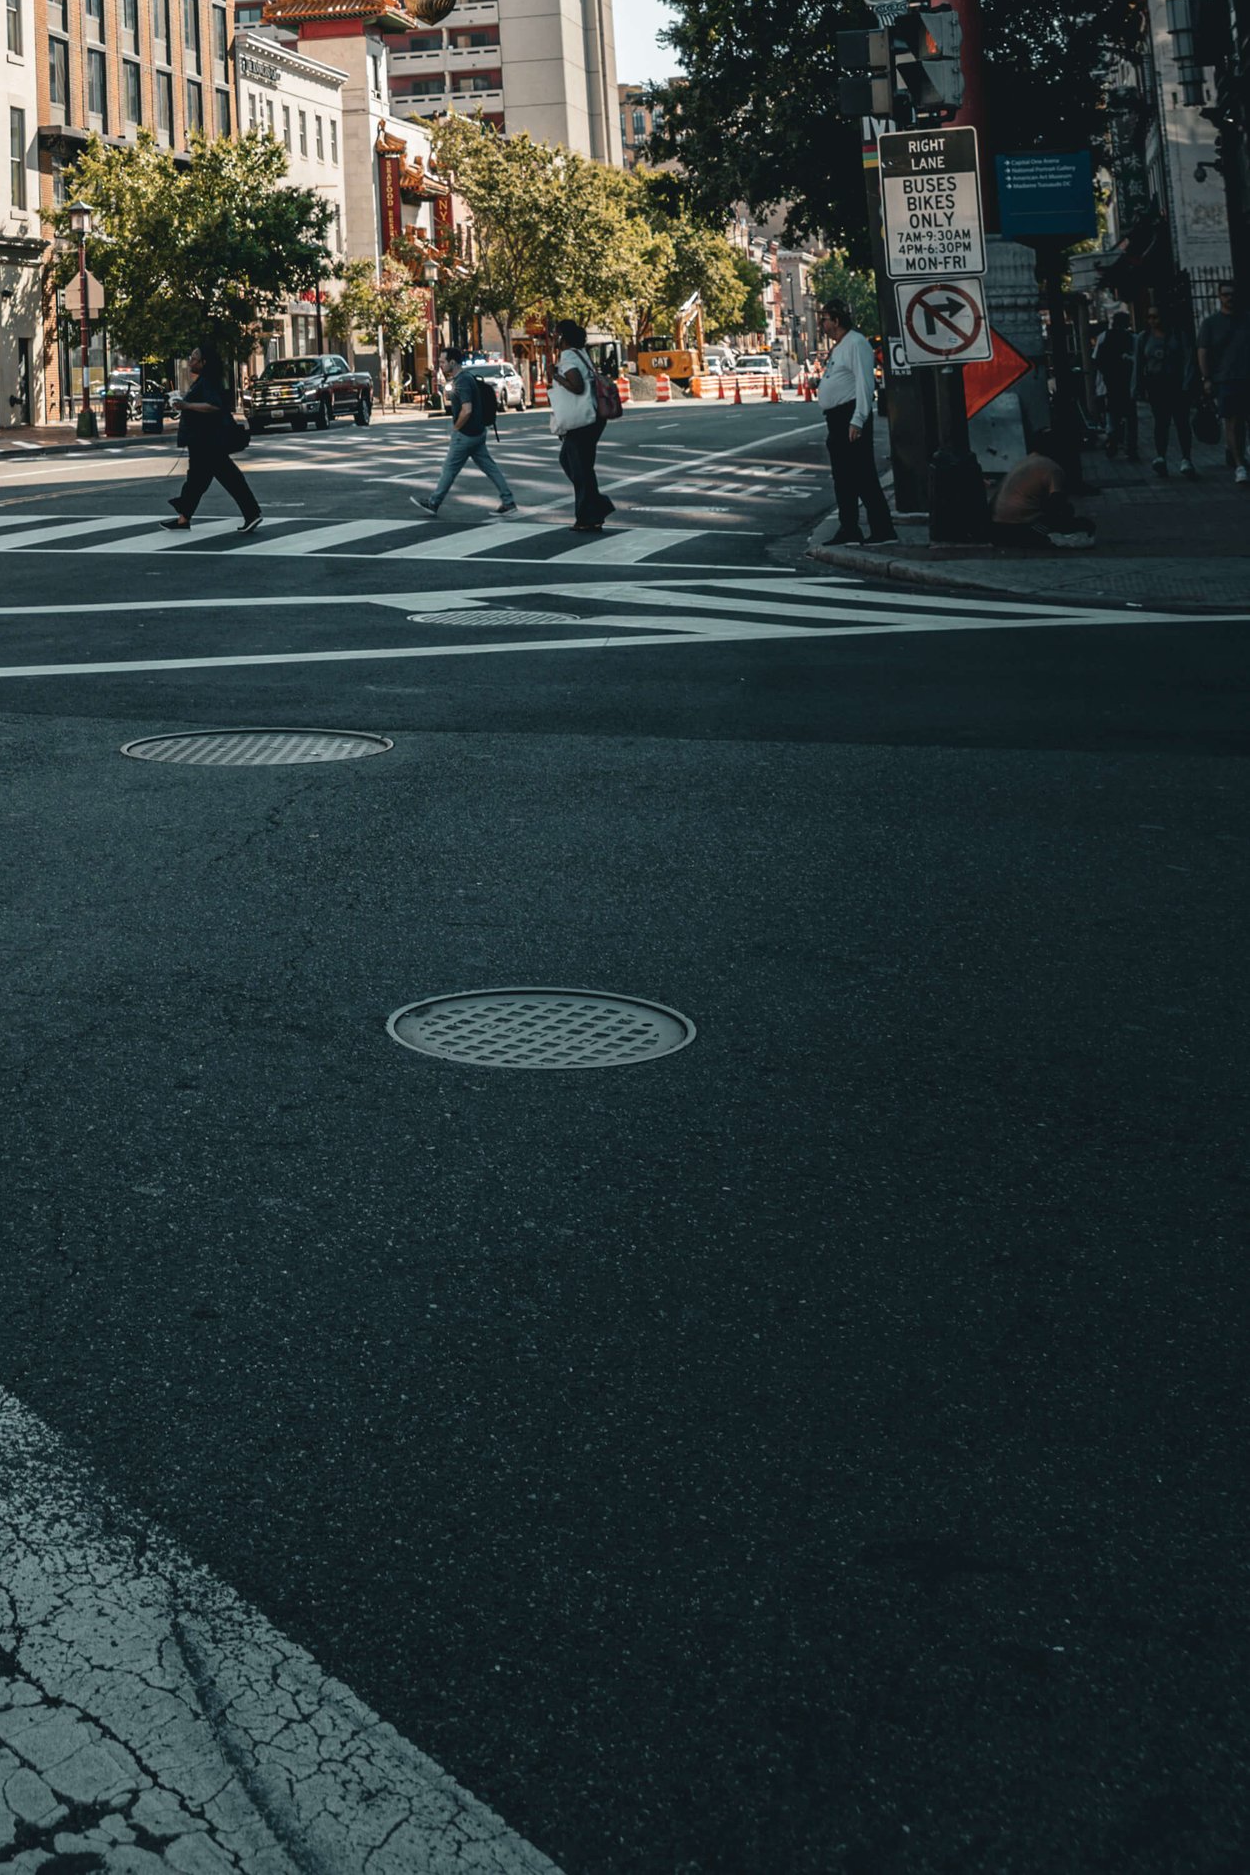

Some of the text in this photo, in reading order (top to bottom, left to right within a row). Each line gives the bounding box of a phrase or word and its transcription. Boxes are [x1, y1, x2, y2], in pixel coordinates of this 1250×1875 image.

[908, 138, 945, 153] RIGHT
[911, 156, 945, 170] LANE
[903, 176, 957, 194] BUSES
[907, 194, 955, 212] BIKES
[909, 211, 955, 229] ONLY
[897, 229, 971, 244] 7AM-9:30AM
[898, 242, 972, 255] 4PM-6:30PM
[905, 256, 967, 271] MON-FRI
[651, 357, 669, 369] CAT
